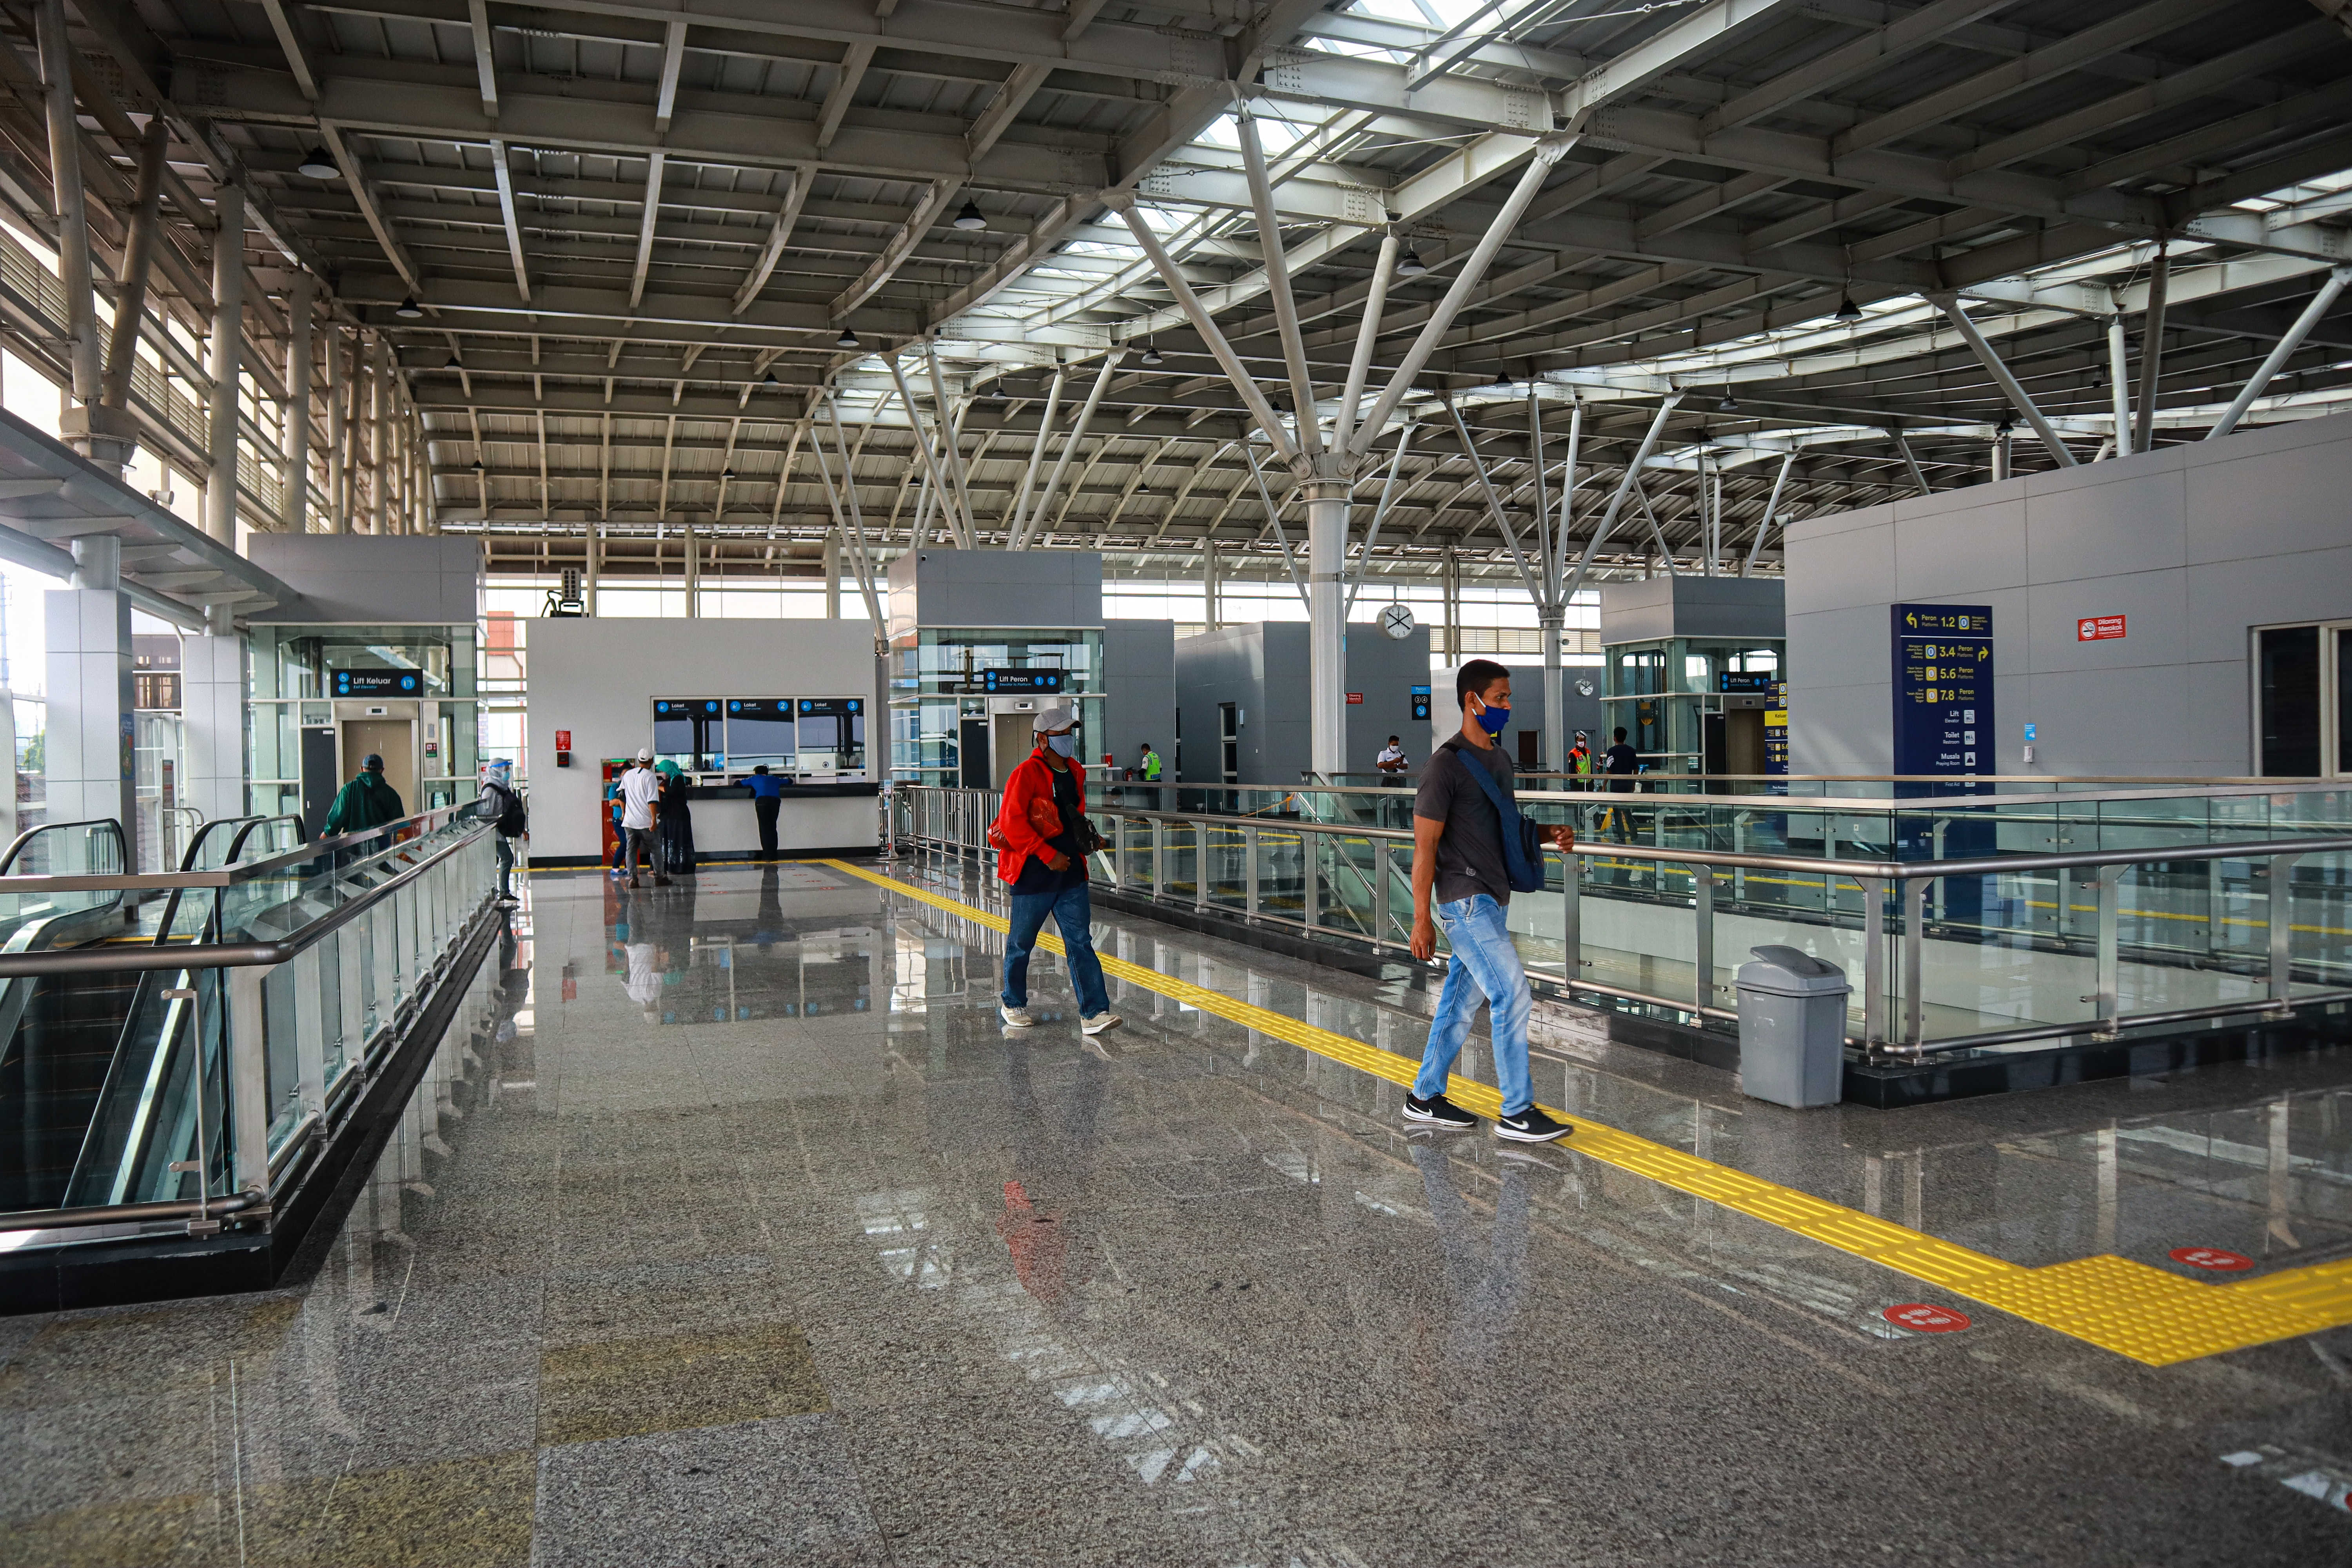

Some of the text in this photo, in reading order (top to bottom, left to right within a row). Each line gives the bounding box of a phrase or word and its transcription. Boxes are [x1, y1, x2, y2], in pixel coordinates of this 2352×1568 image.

[1941, 617, 1955, 627] 1.2
[1940, 646, 1956, 657] 3.4
[1940, 668, 1956, 679] 5.6
[1940, 690, 1955, 700] 7.8
